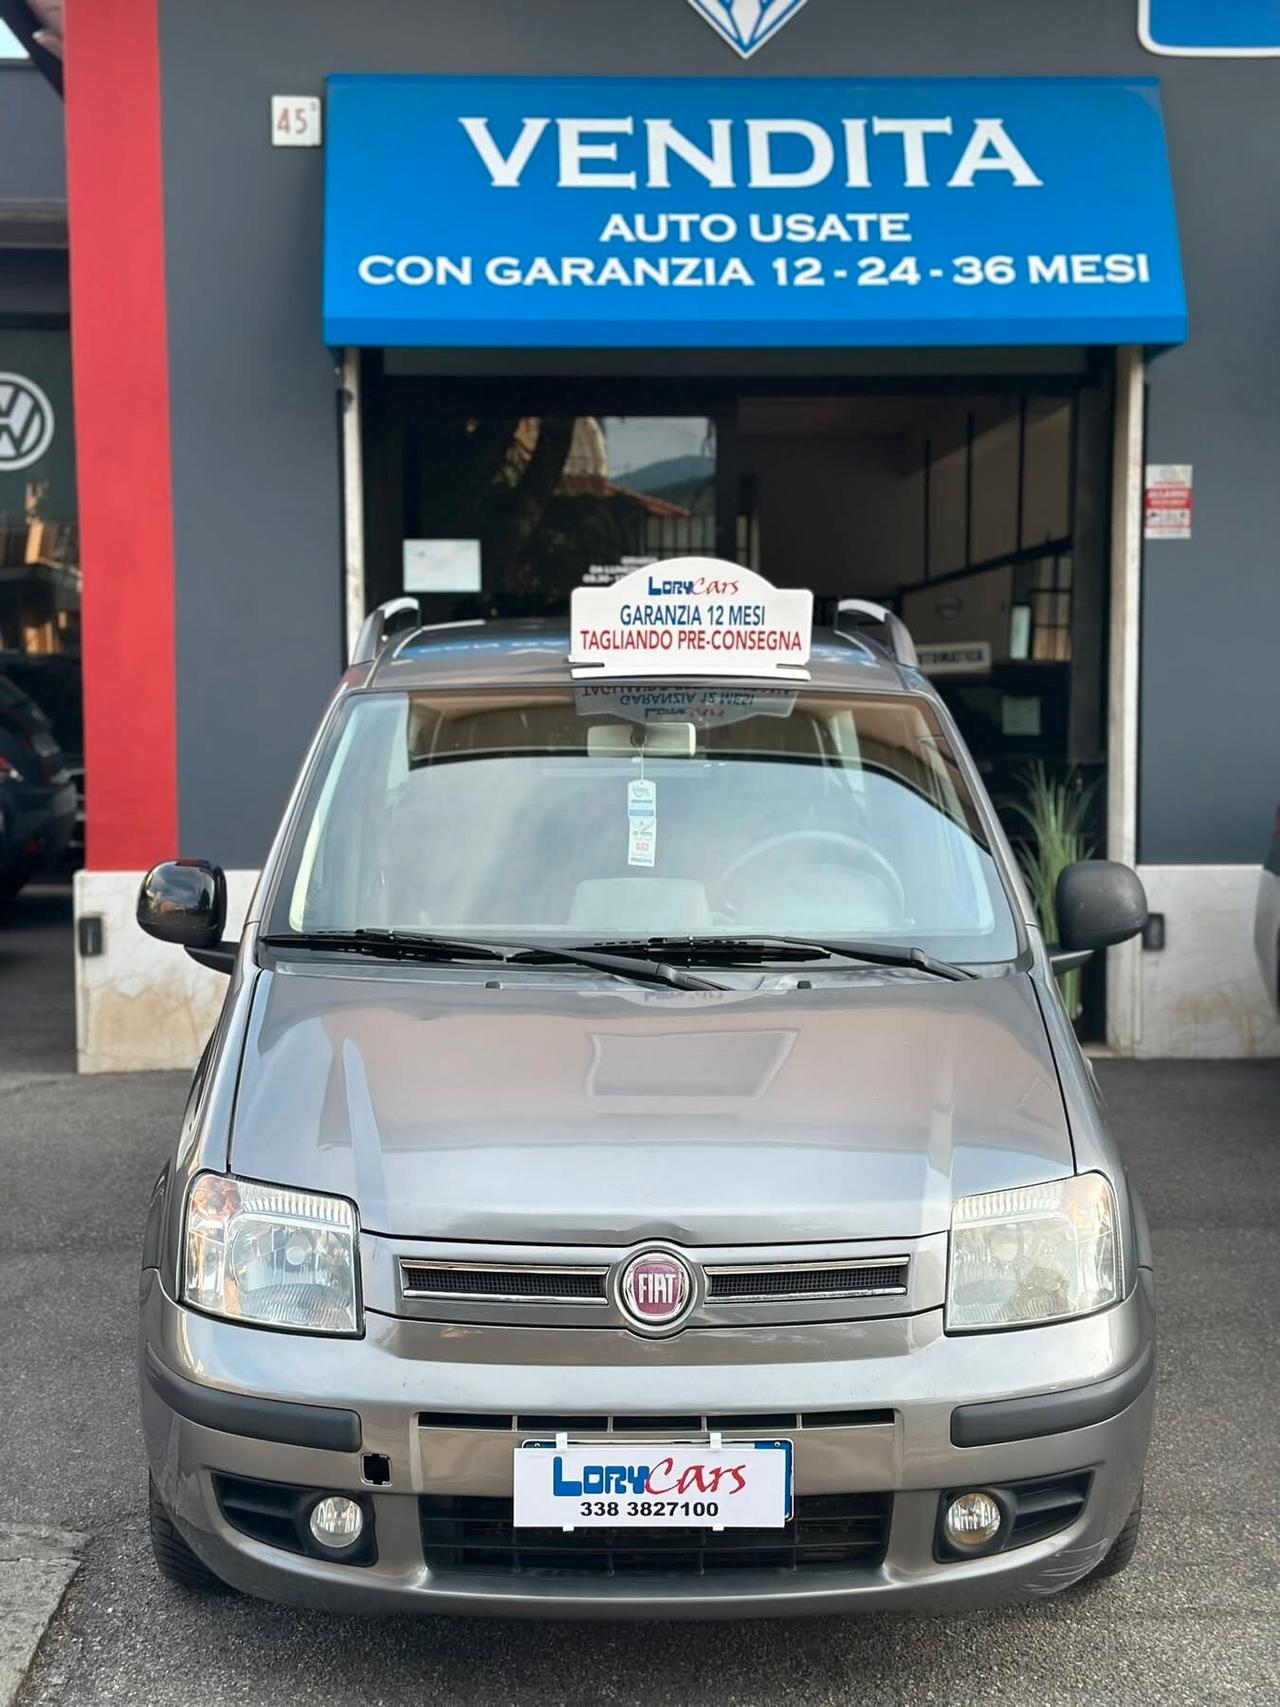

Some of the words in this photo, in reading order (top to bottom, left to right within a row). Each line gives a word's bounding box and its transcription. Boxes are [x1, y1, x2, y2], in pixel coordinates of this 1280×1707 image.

[459, 116, 1043, 189] VENDITA
[601, 213, 737, 243] AUTO
[750, 213, 911, 243] USATE
[358, 255, 472, 286] CON
[485, 256, 754, 287] GARANZIA
[772, 257, 825, 287] 12
[858, 256, 921, 287] 24
[953, 255, 1016, 286] 36
[1028, 253, 1150, 285] MESI
[620, 604, 702, 626] GARANZIA
[707, 605, 724, 626] 12
[728, 605, 765, 627] MESI
[580, 629, 673, 650] TAGLIANDO
[678, 629, 802, 652] PRE-CONSEGNA
[638, 1273, 677, 1304] FIAT
[580, 1501, 620, 1517] 338
[626, 1501, 719, 1517] 3827100
